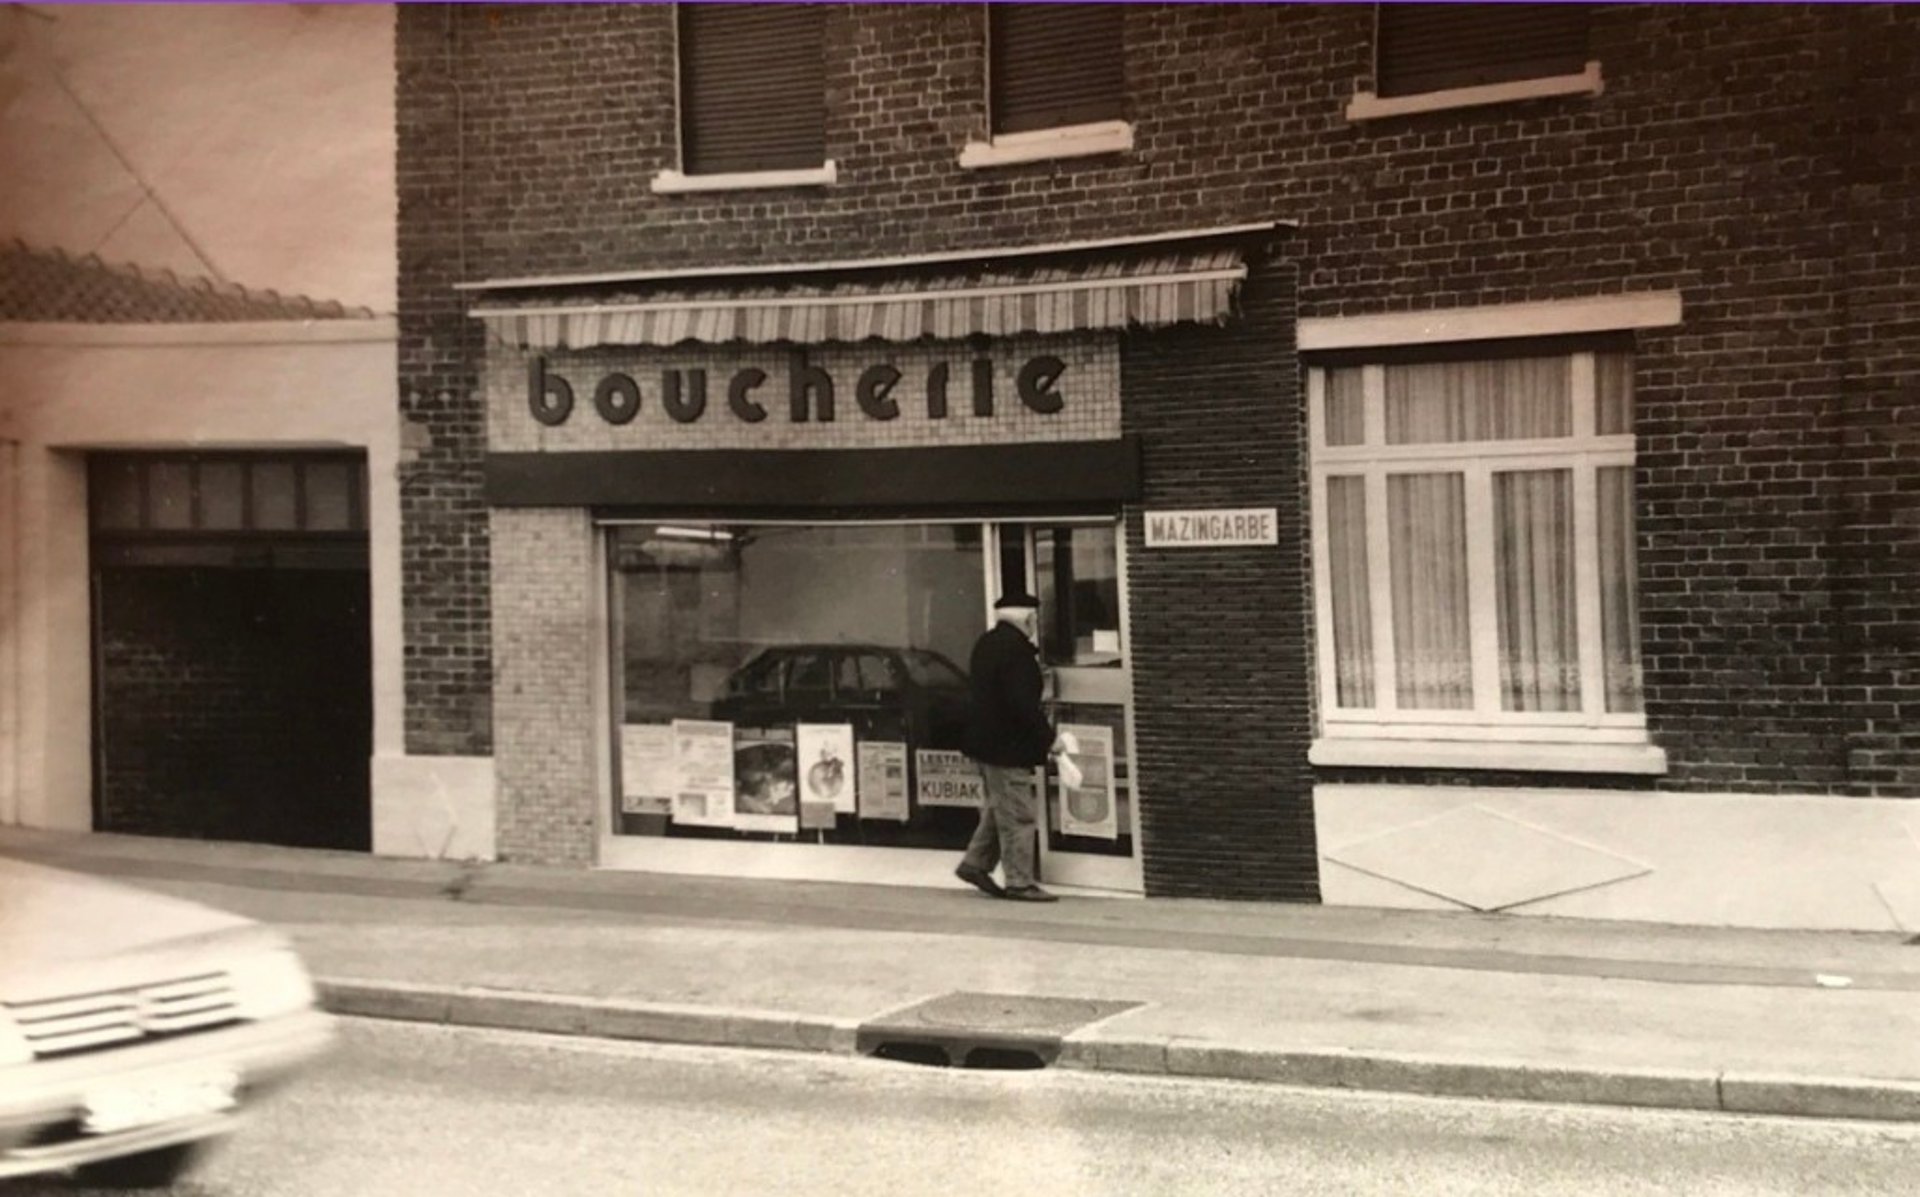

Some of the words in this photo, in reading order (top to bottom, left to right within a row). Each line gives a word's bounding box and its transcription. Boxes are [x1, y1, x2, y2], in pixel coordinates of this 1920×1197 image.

[528, 351, 1067, 427] boucherie
[1151, 514, 1270, 541] MAZINGARBE
[921, 781, 981, 799] KUBIAK
